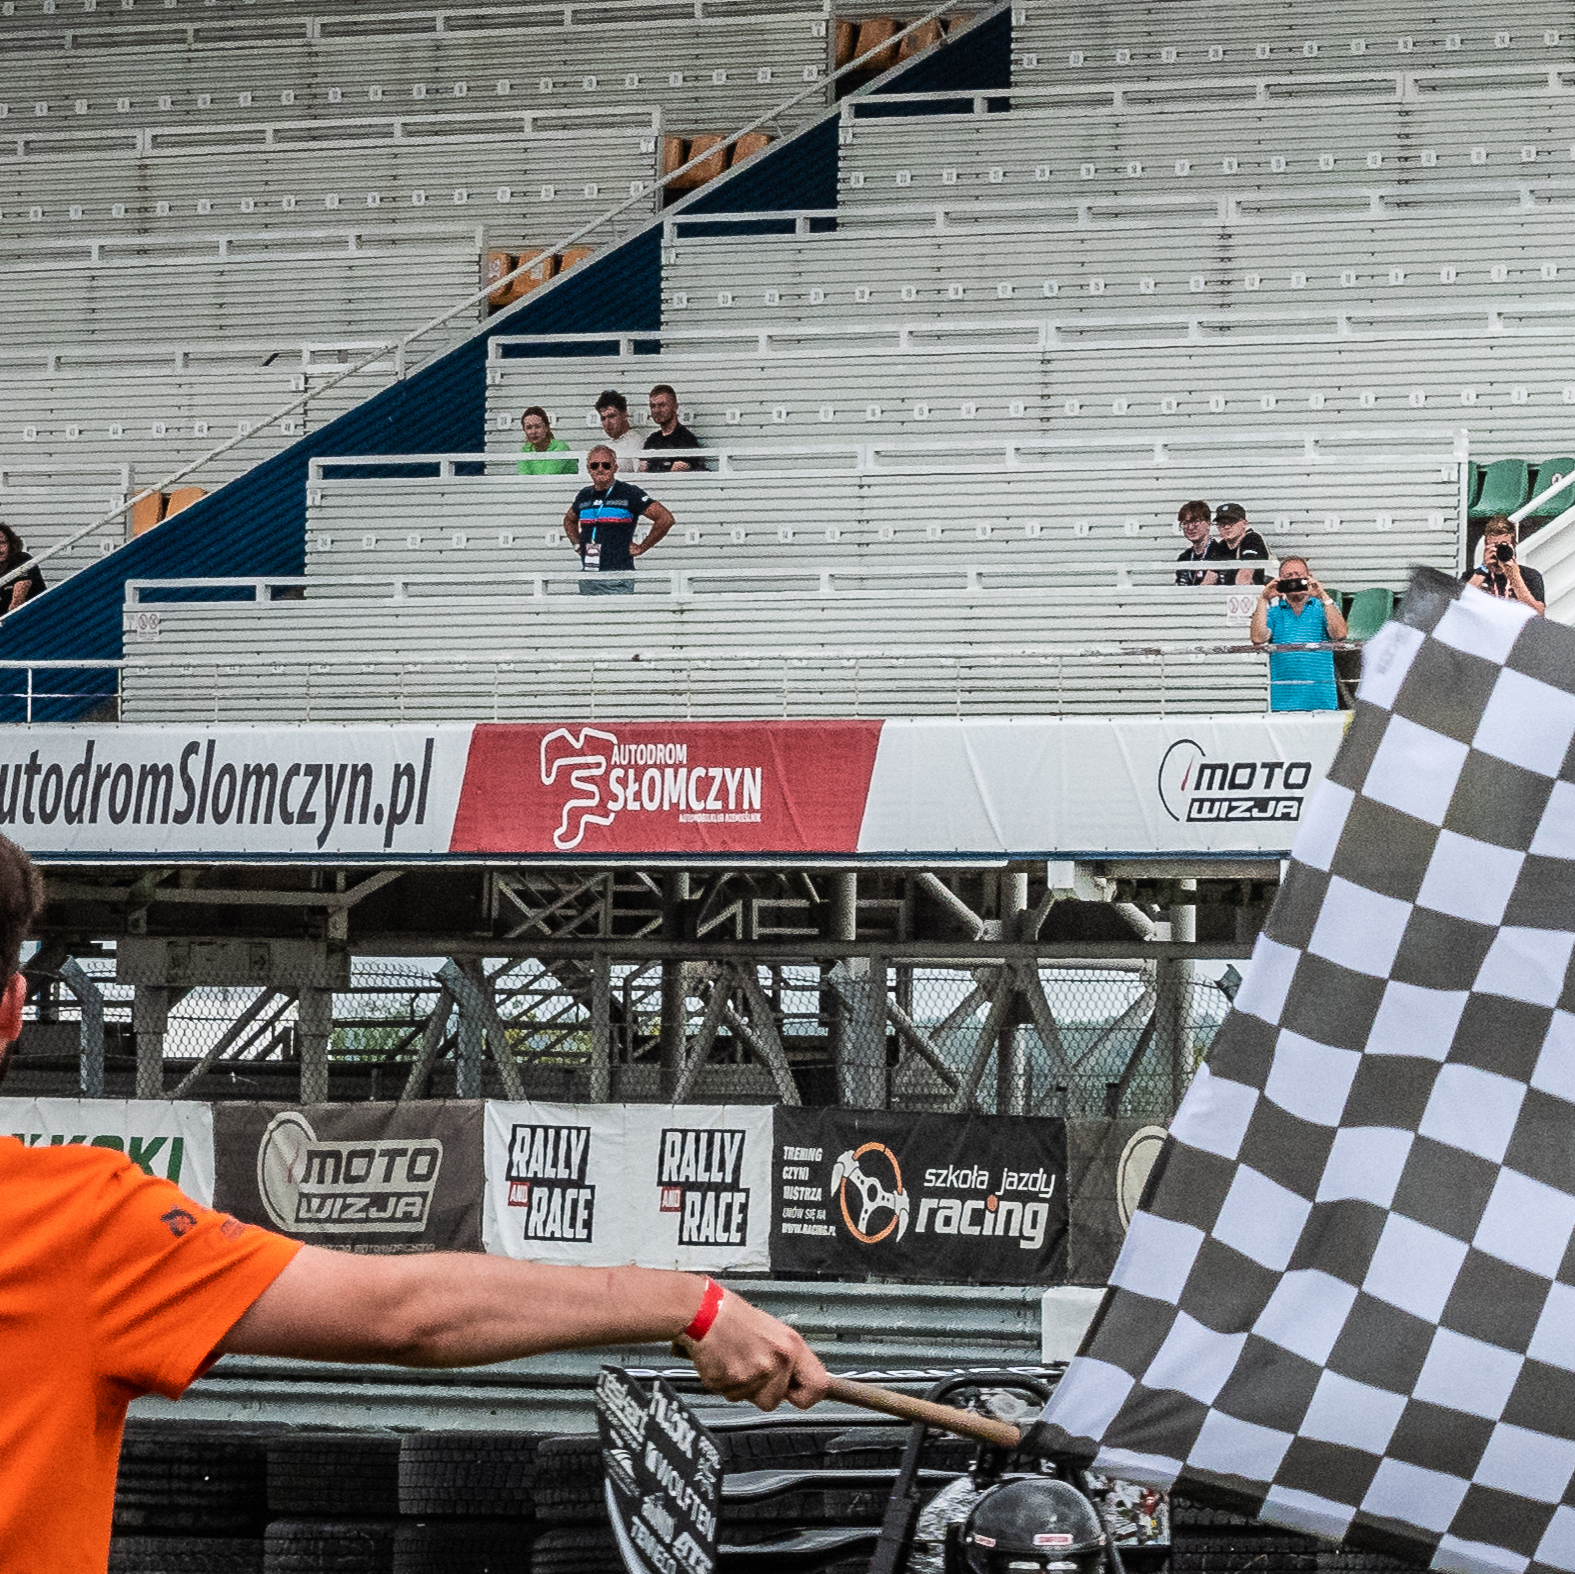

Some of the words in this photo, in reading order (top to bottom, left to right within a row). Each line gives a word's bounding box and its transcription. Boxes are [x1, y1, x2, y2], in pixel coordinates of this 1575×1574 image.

[610, 743, 688, 765] AUTODROM
[607, 767, 762, 811] SŁOMCZYN
[1194, 761, 1312, 791] MOTO
[1189, 800, 1300, 819] WIZJA
[304, 1147, 435, 1184] MOTO
[511, 1127, 588, 1179] RALLY
[662, 1131, 743, 1183] RALLY
[924, 1165, 989, 1190] szkoła
[996, 1167, 1055, 1198] jazdy
[299, 1193, 424, 1219] WIZJA
[528, 1187, 593, 1239] RACE
[682, 1191, 746, 1243] RACE
[915, 1195, 1049, 1249] racing
